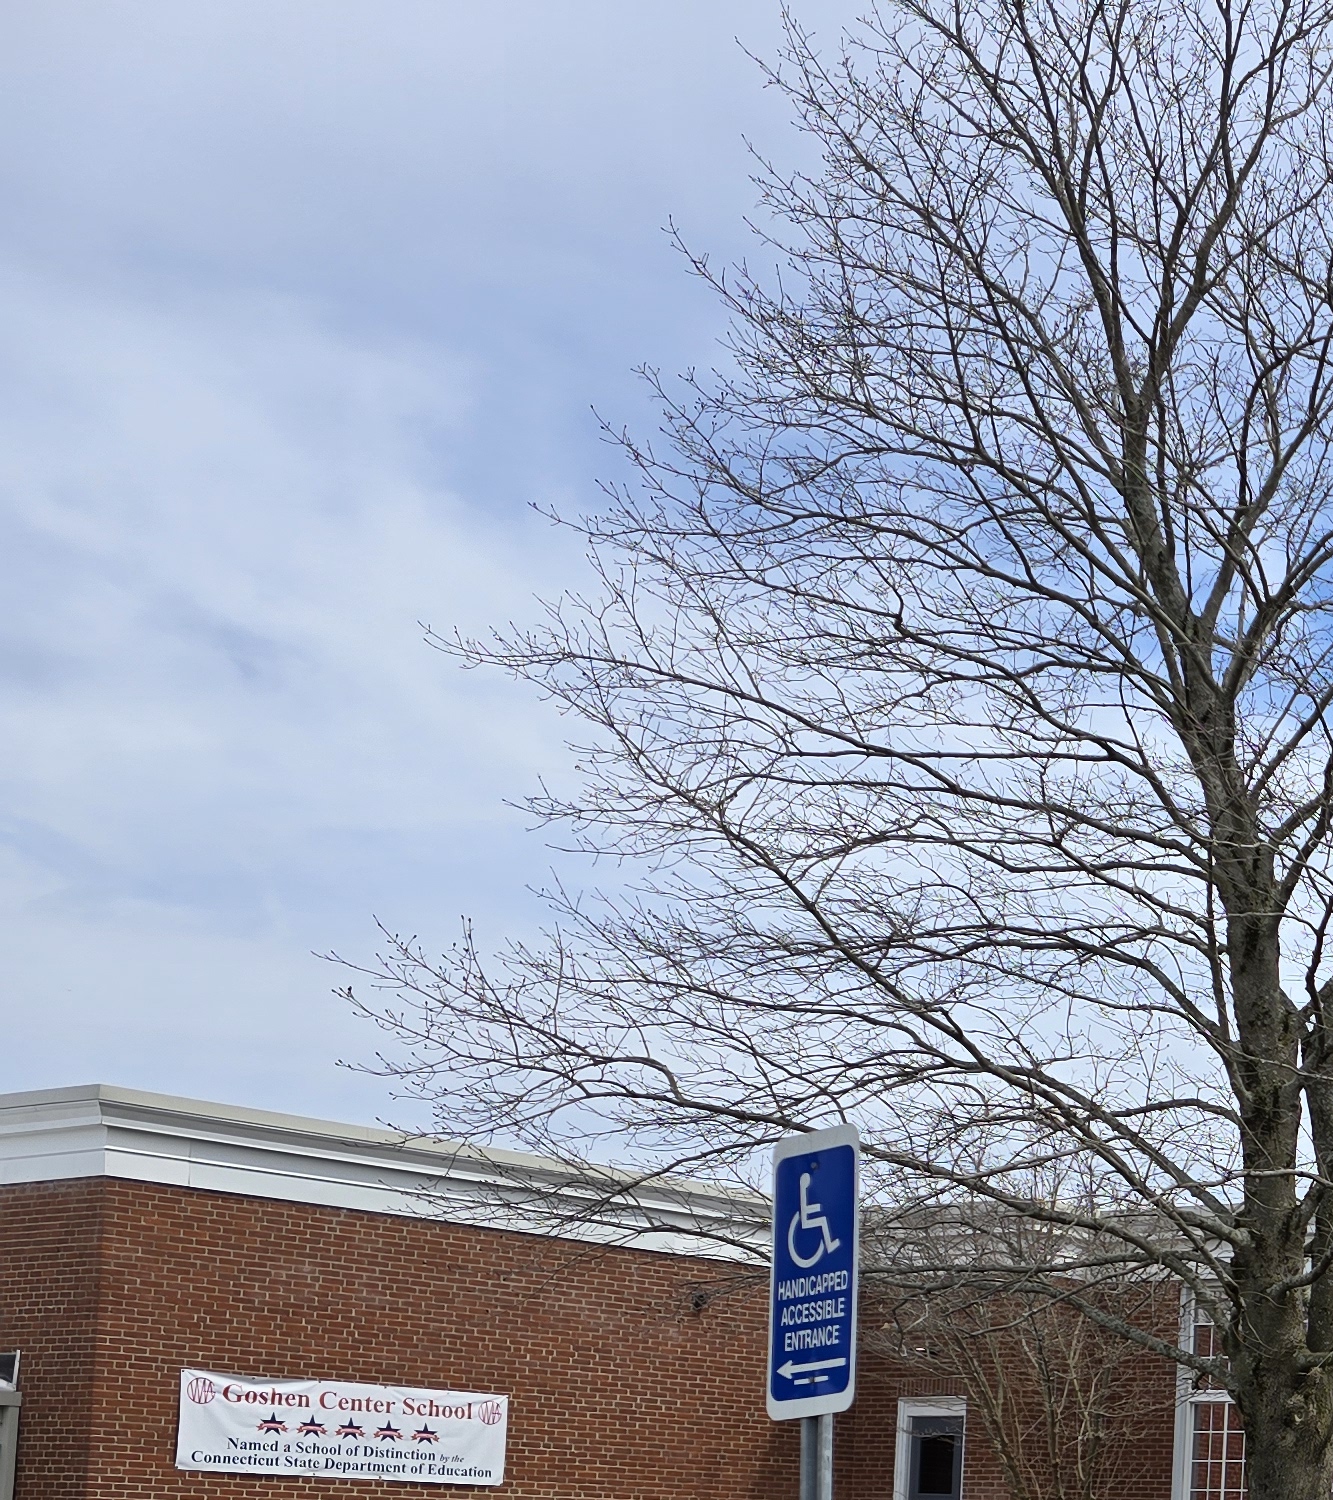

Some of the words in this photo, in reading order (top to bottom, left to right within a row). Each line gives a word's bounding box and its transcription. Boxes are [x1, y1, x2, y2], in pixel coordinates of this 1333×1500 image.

[777, 1270, 848, 1301] HANDICAPPED
[780, 1297, 845, 1327] ACCESSIBLE
[784, 1324, 840, 1352] ENTRANCE
[222, 1383, 311, 1408] Goshen
[319, 1391, 396, 1414] Center
[402, 1397, 473, 1420] School
[191, 1450, 280, 1467] Connecticut
[284, 1455, 320, 1469] State
[324, 1457, 406, 1474] Department
[410, 1463, 425, 1475] of
[428, 1463, 492, 1478] Education
[227, 1437, 279, 1452] Named
[283, 1443, 291, 1453] a
[295, 1441, 342, 1456] School
[345, 1445, 360, 1457] of
[363, 1445, 436, 1461] Distinction
[439, 1453, 450, 1463] by
[451, 1454, 465, 1463] the
